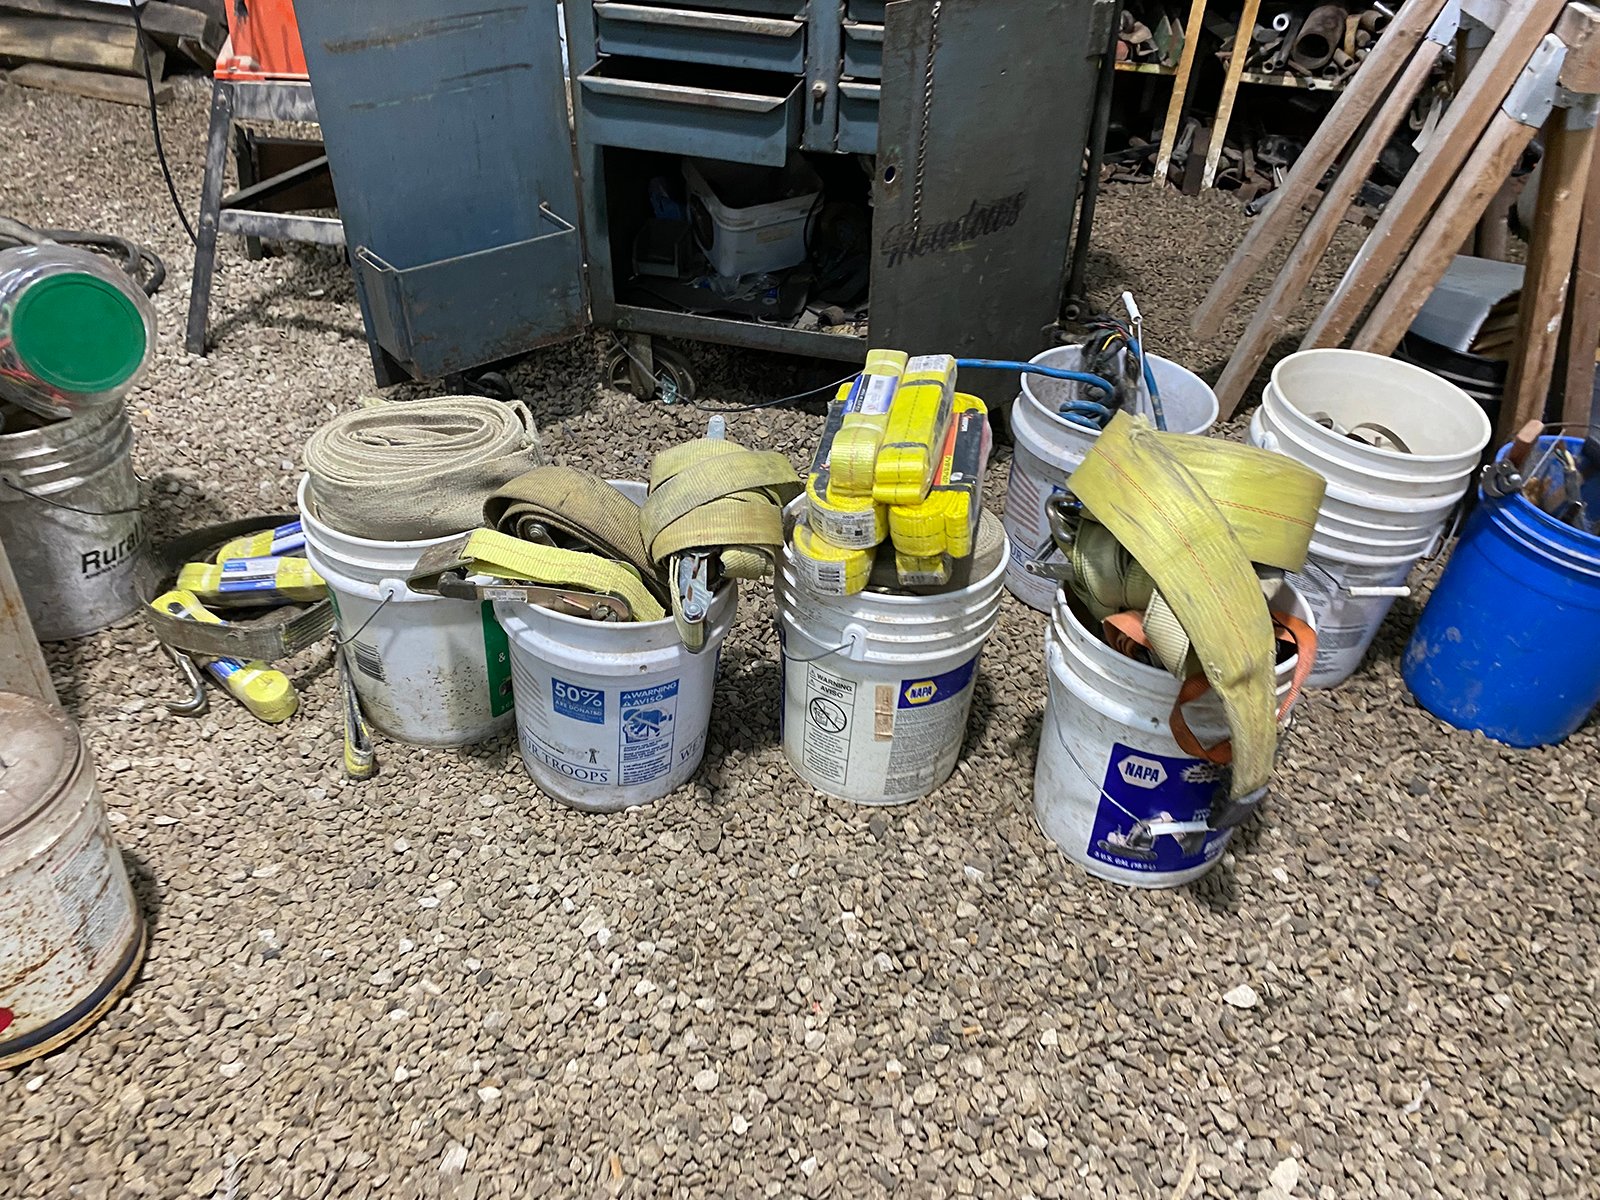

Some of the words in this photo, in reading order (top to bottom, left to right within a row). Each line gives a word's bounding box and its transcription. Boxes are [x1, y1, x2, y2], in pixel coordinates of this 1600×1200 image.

[81, 521, 140, 574] Rural
[631, 681, 677, 698] WARNING
[816, 672, 852, 692] WARNING
[820, 685, 844, 699] AVISO
[909, 685, 933, 699] NAPA
[554, 681, 603, 707] 50%
[632, 694, 663, 706] AVISO
[542, 752, 608, 782] TROOPS
[1124, 761, 1160, 783] NAPA
